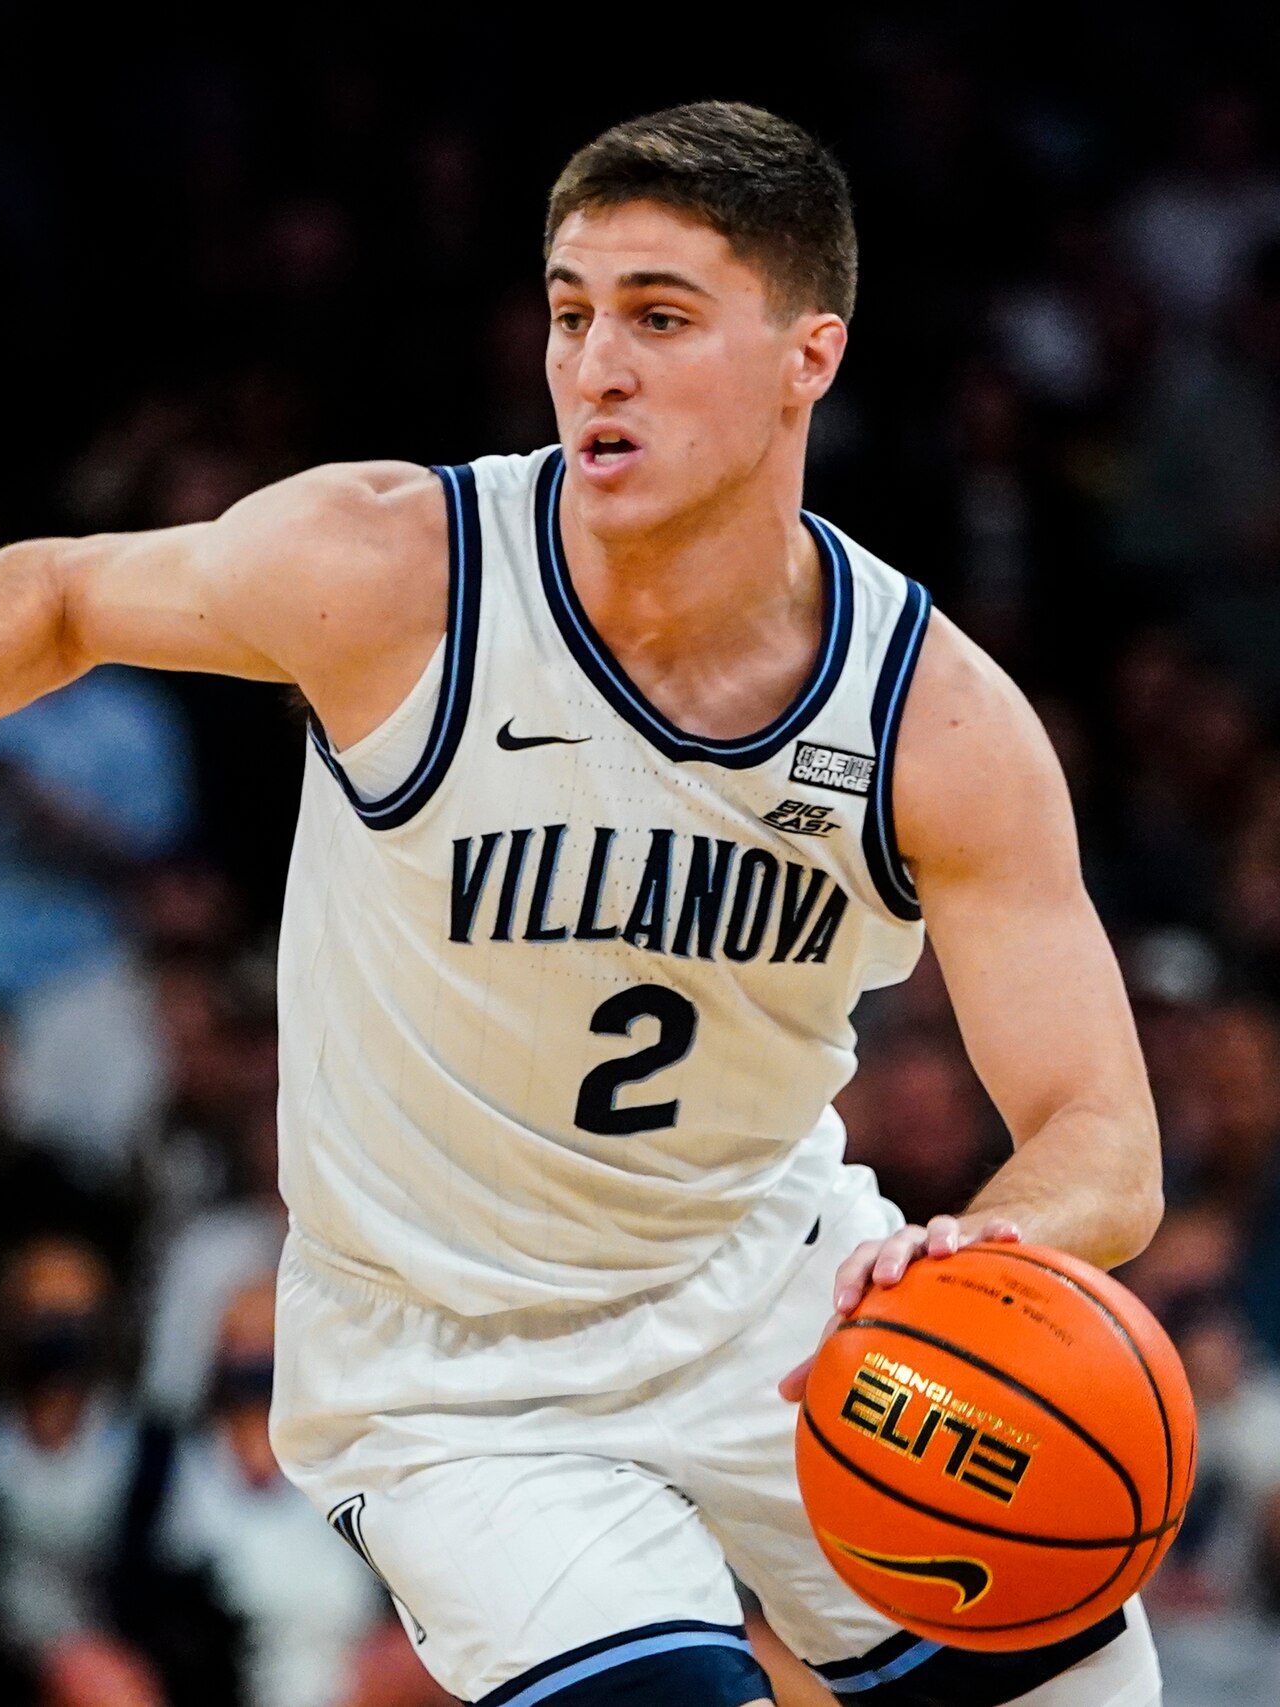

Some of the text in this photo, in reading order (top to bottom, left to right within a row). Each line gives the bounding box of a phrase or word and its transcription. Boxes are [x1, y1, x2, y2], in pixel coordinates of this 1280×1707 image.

[776, 799, 835, 819] BIG
[793, 765, 872, 793] CHANGE
[762, 811, 842, 833] EAST
[449, 824, 849, 964] VILLANOVA
[574, 984, 699, 1136] 2
[839, 1365, 1032, 1507] ELITE
